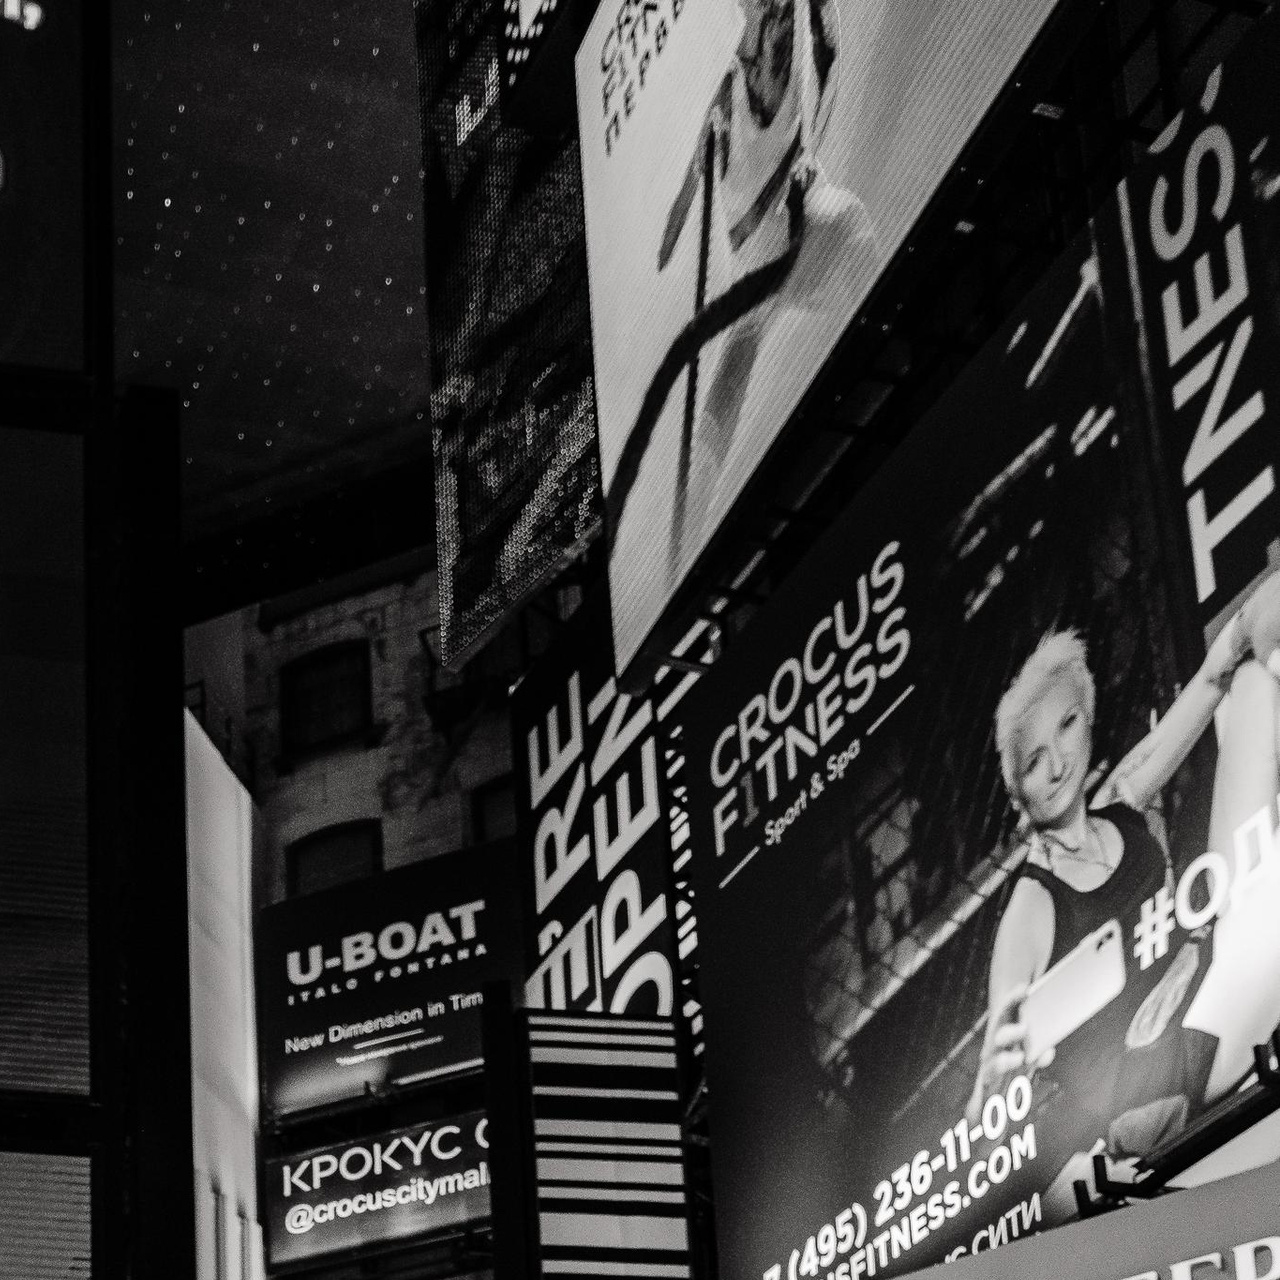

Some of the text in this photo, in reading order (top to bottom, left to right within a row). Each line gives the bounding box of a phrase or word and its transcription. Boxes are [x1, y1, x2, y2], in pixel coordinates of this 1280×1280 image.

[1148, 62, 1274, 603] TNES
[710, 540, 906, 788] CROCUS
[764, 740, 861, 846] Sport & Spa
[1134, 800, 1280, 972] #ОД
[286, 899, 486, 986] U-BOAT
[287, 943, 488, 1007] ITALO FONTANA
[284, 1032, 325, 1055] New
[328, 1006, 424, 1044] Dimension
[426, 1000, 446, 1018] in
[282, 1124, 463, 1198] КРОКУС
[872, 1074, 1033, 1228] 236-11-00
[971, 1191, 1042, 1256] СИТИ
